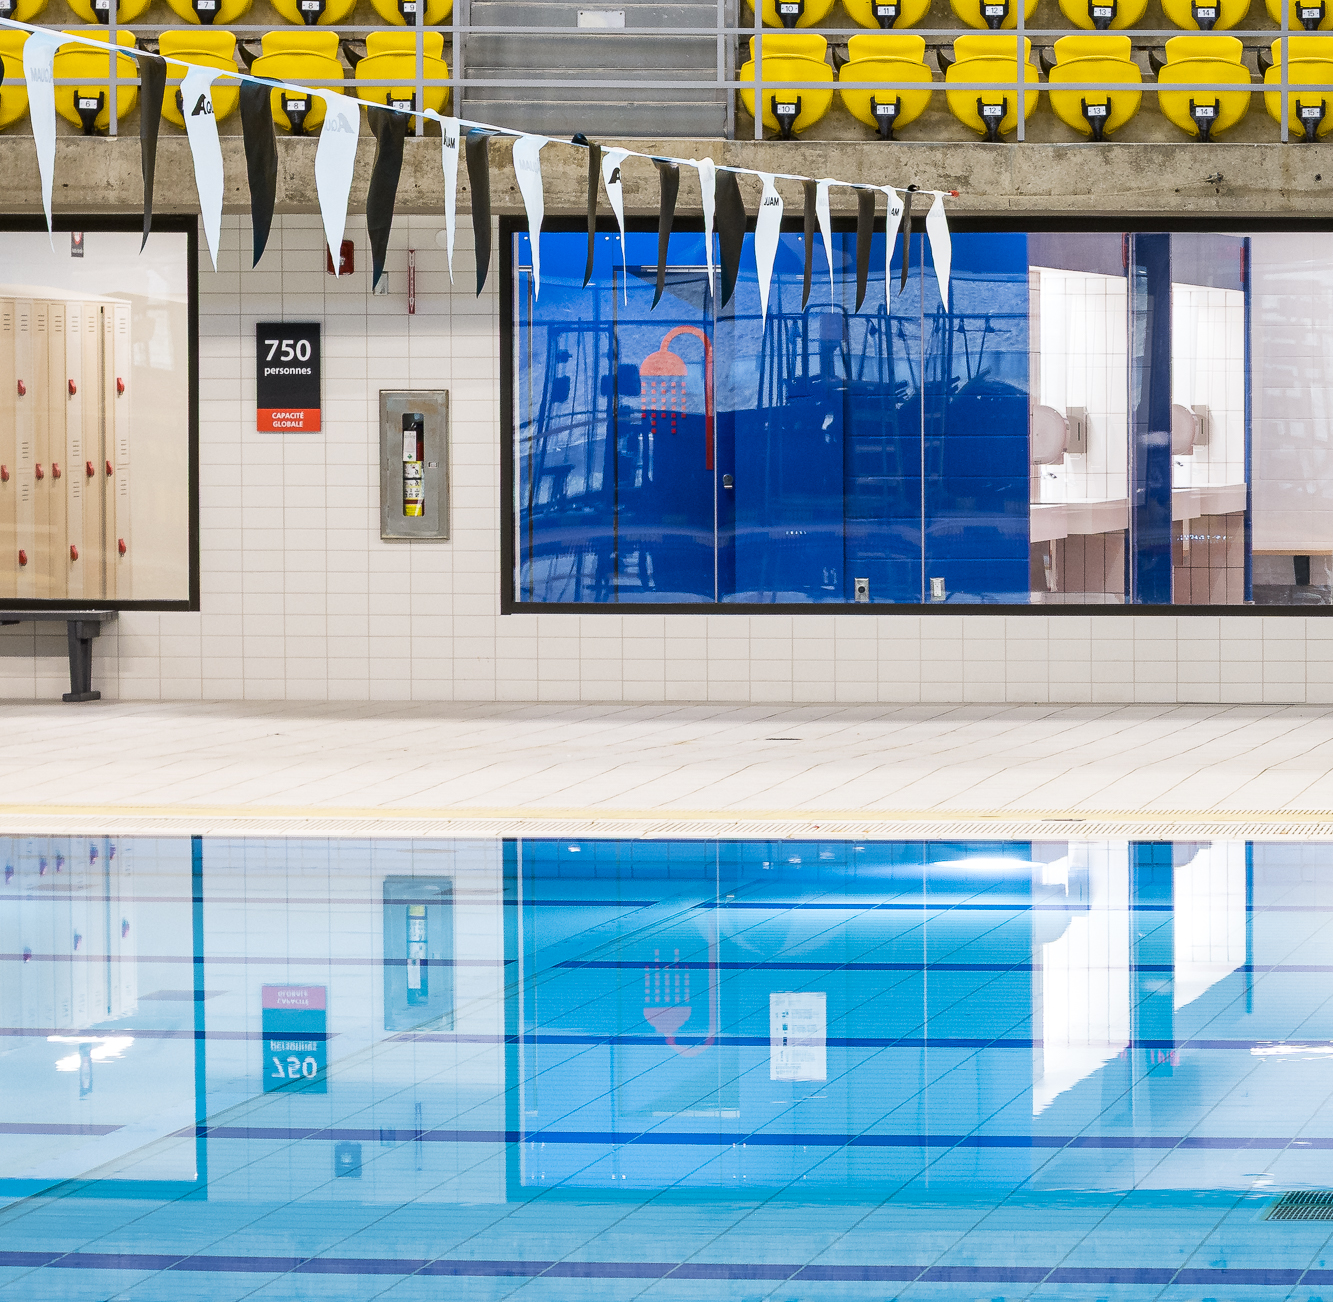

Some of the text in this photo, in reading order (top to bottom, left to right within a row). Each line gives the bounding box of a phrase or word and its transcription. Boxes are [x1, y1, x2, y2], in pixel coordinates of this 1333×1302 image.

[264, 339, 312, 362] 750
[264, 367, 312, 377] personnes
[271, 411, 305, 419] CAPACITÉ
